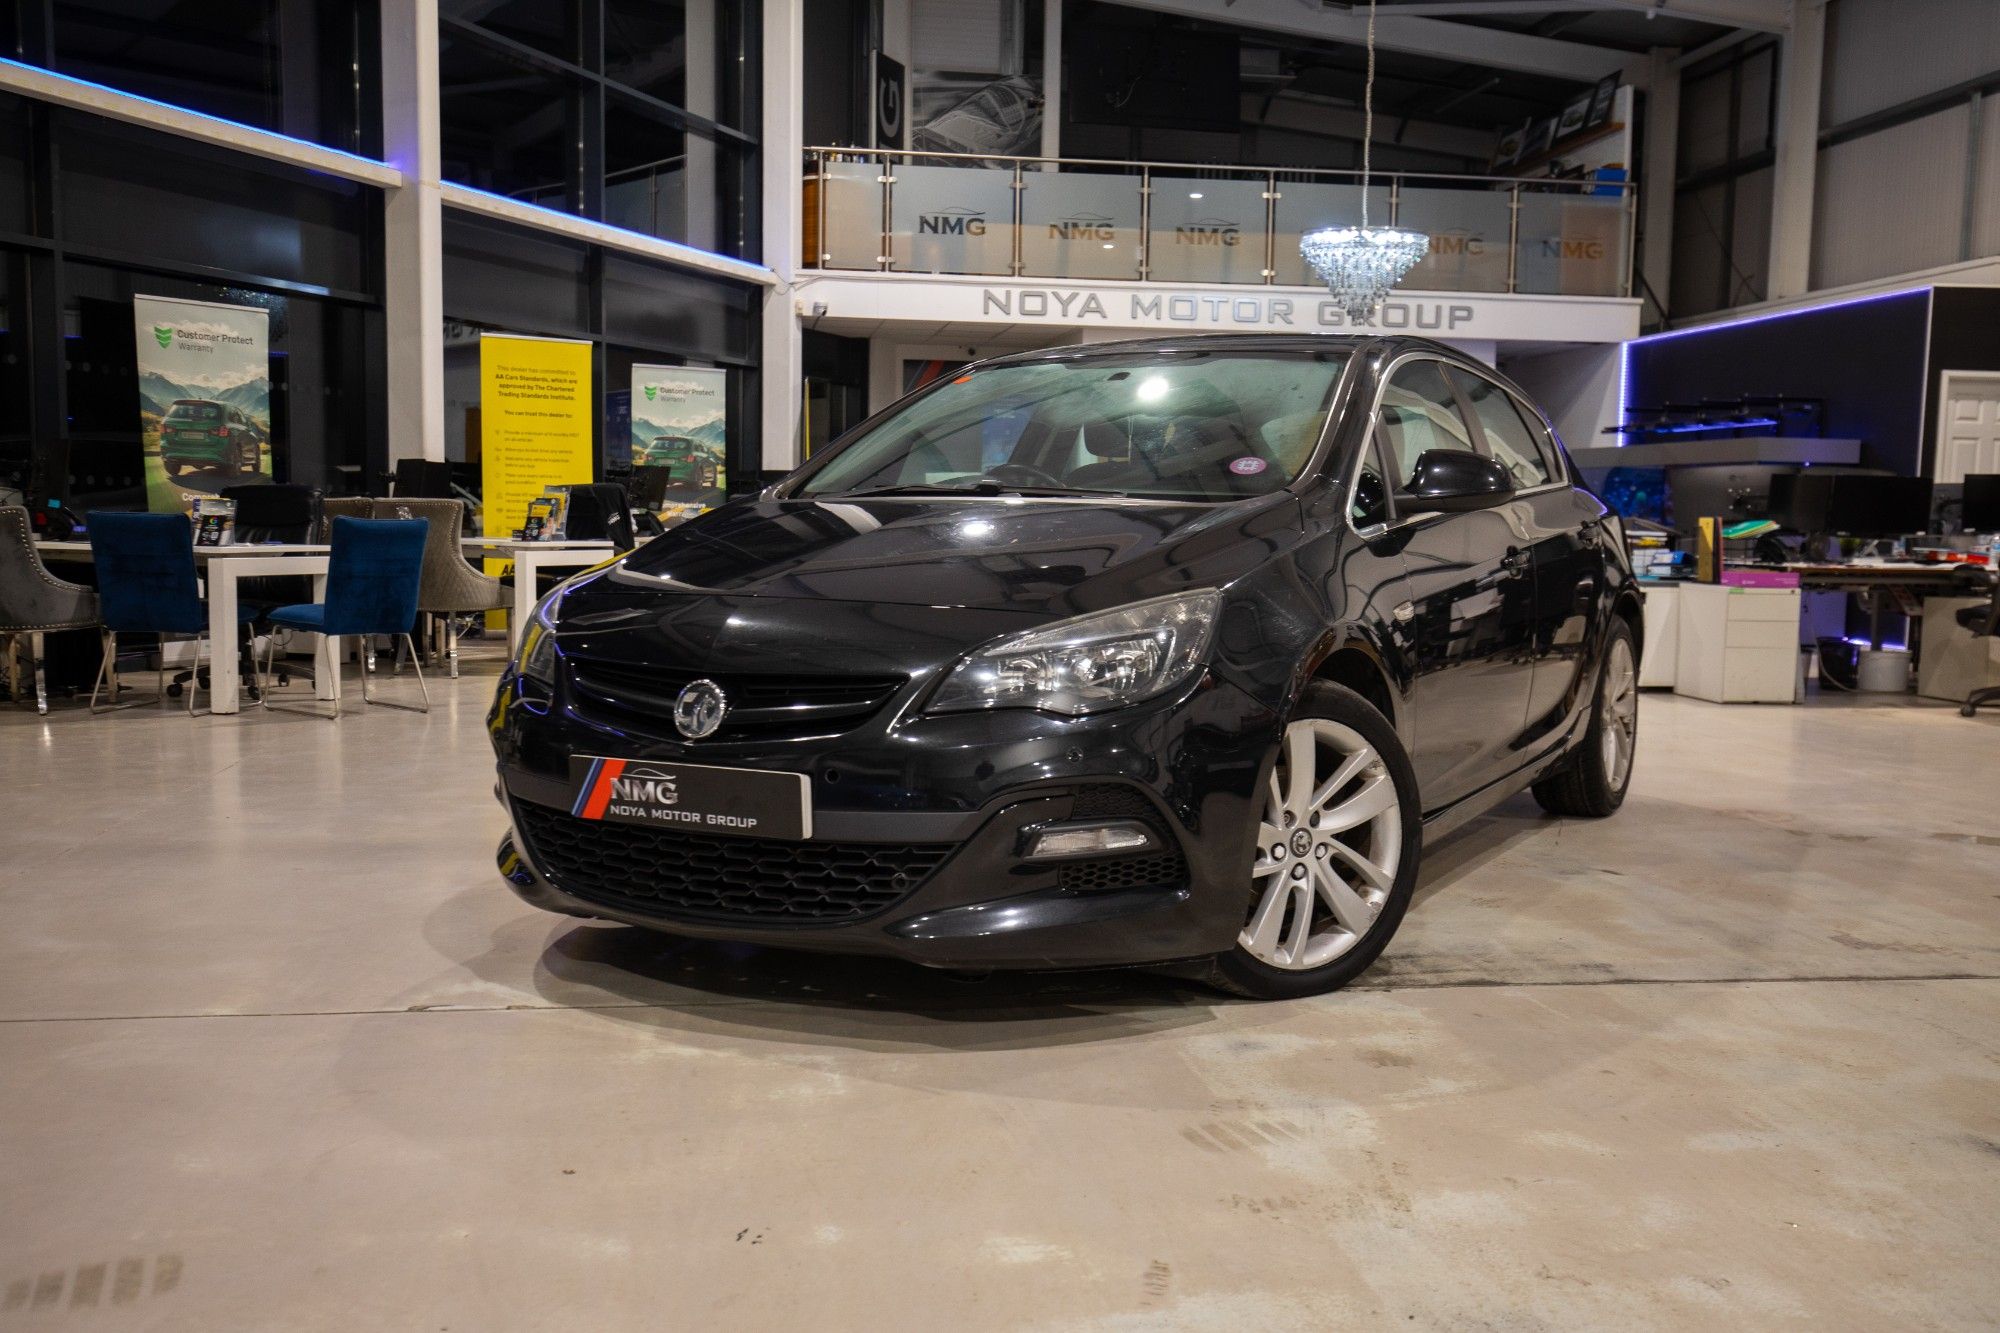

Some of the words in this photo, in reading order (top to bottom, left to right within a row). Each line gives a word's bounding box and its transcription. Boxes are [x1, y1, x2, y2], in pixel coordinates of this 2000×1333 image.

[919, 215, 986, 236] NMG
[1050, 222, 1115, 241] NMG
[1176, 226, 1240, 246] NMG
[1542, 240, 1604, 259] NMG
[983, 289, 1107, 319] NOYA
[1131, 293, 1294, 324] MOTOR
[177, 330, 220, 341] Customer
[222, 335, 253, 345] Protect
[178, 343, 214, 353] Warranty
[498, 391, 520, 399] Trading
[610, 777, 678, 805] NMG
[610, 804, 647, 818] NOYA
[651, 809, 701, 823] MOTOR
[706, 814, 758, 829] GROUP
